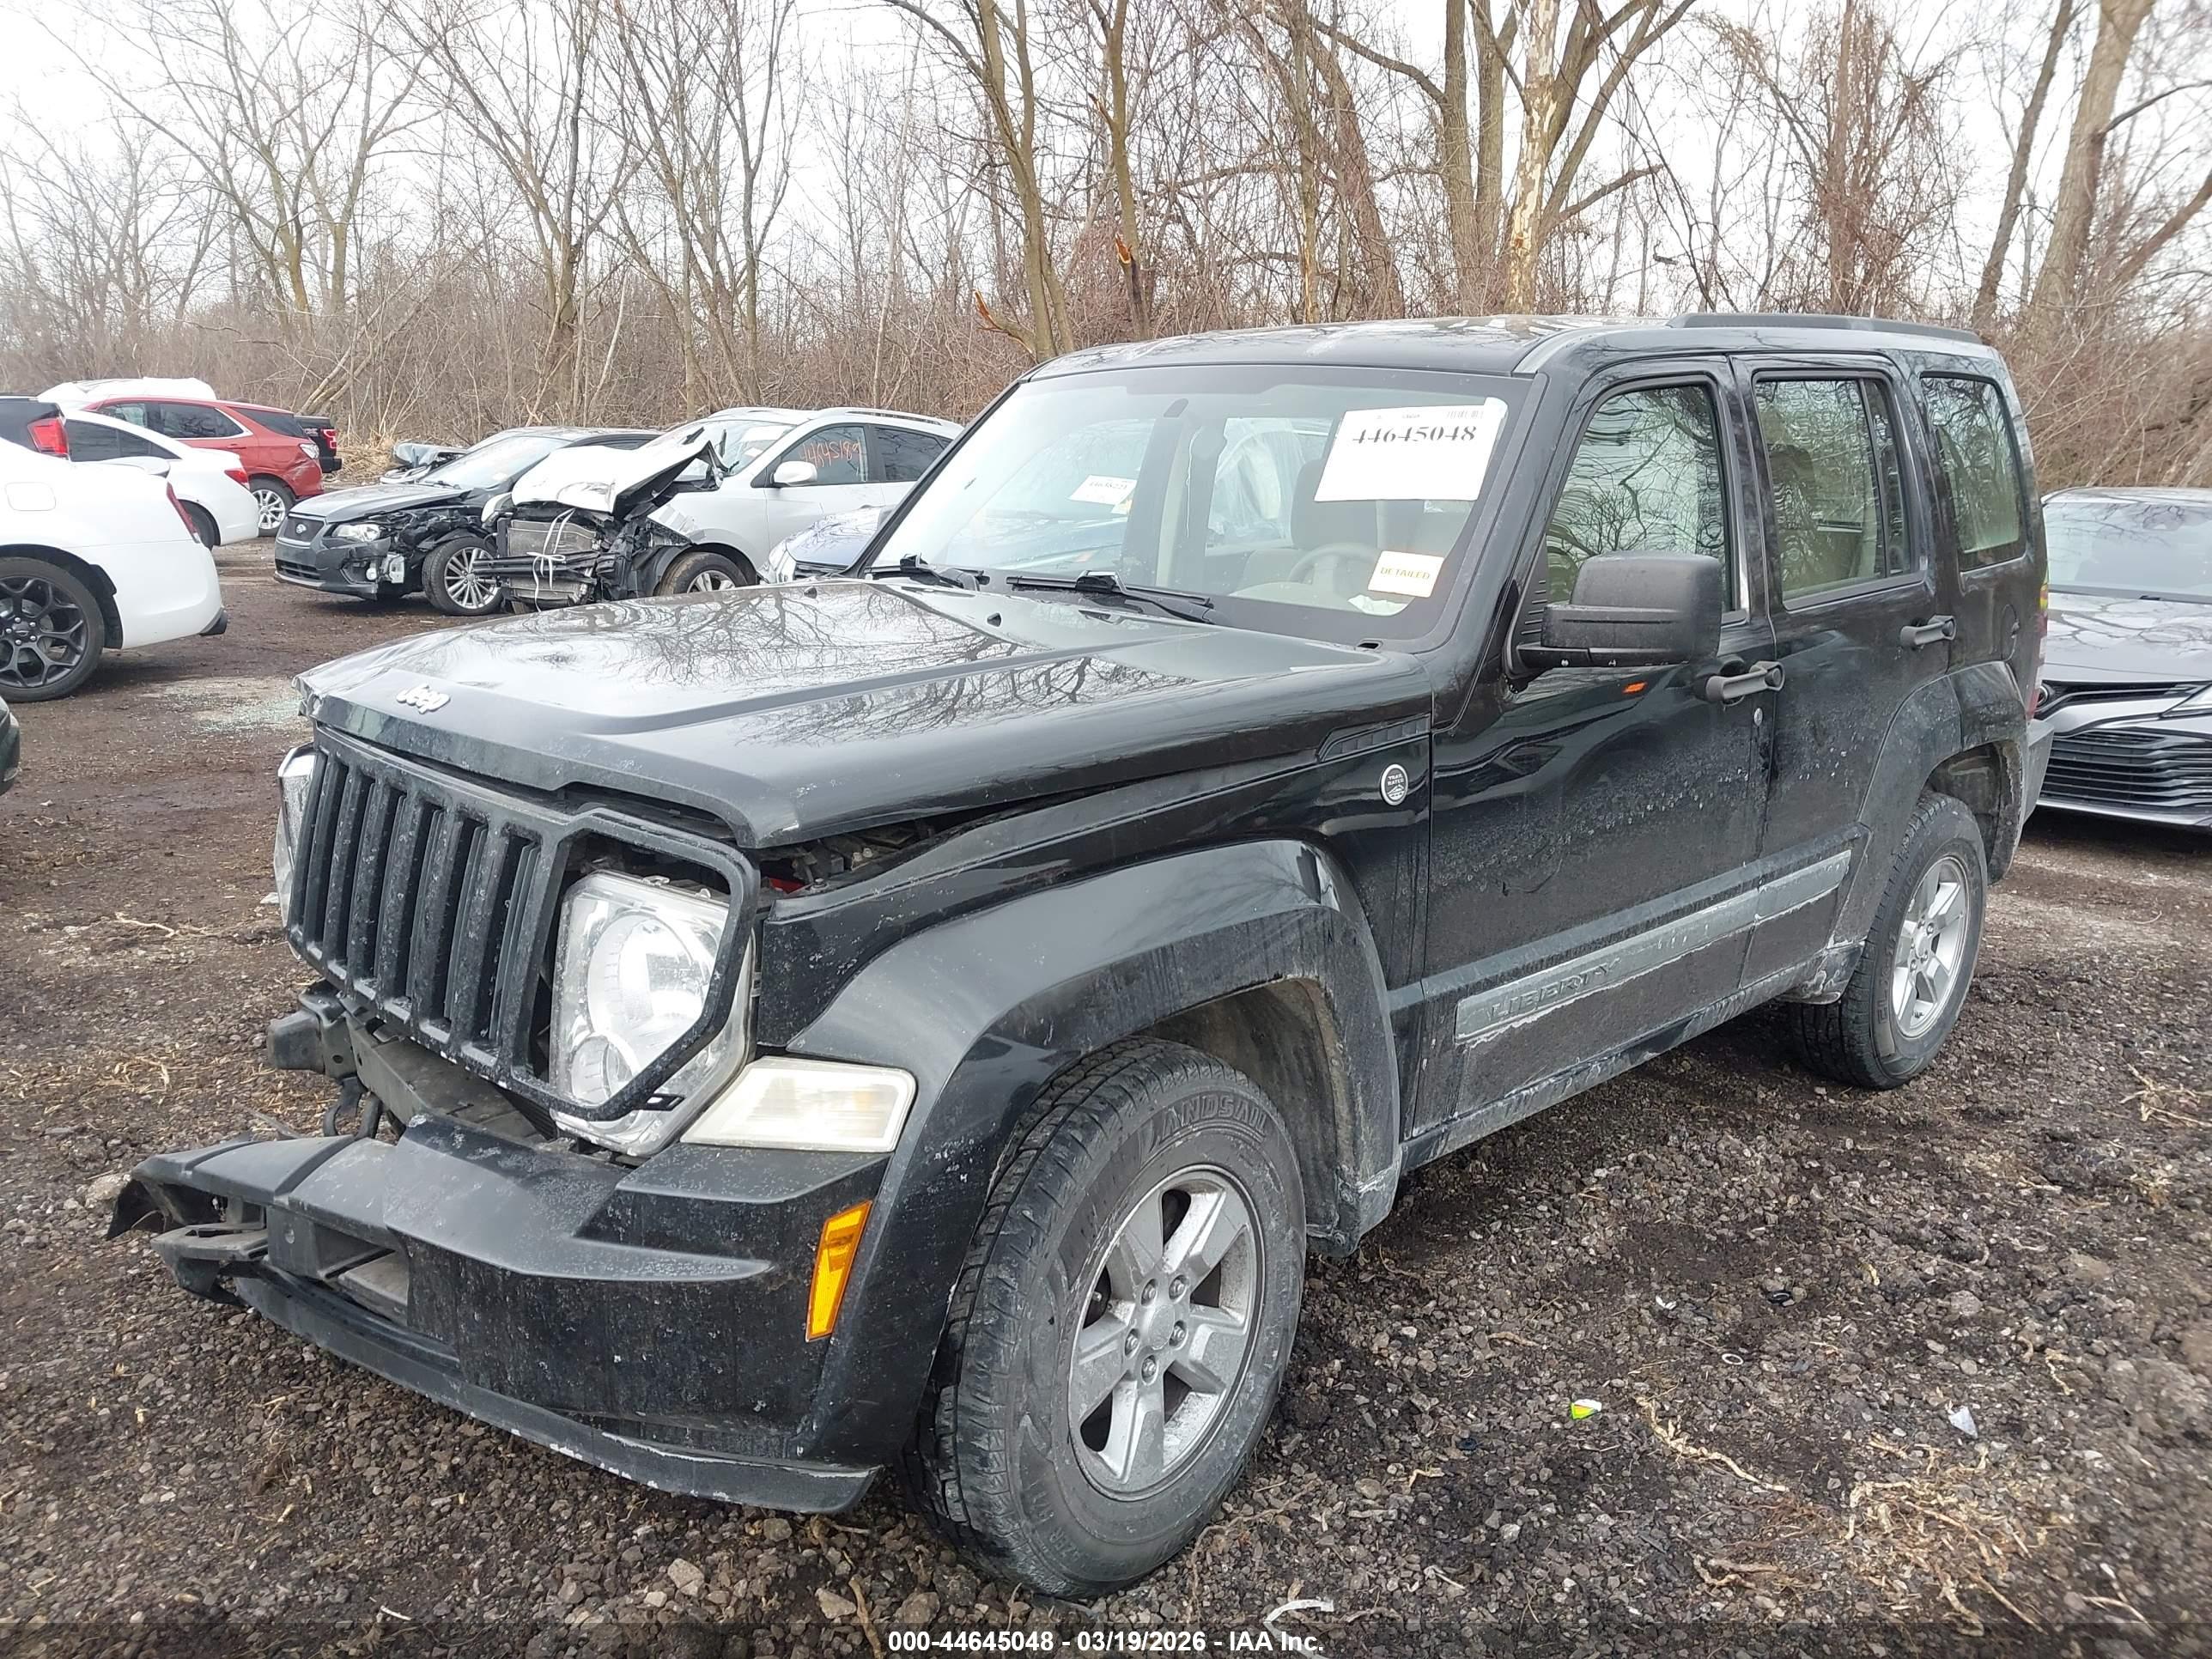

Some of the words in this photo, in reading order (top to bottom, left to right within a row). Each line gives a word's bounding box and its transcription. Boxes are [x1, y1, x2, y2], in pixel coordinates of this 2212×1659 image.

[1352, 425, 1477, 444] 44645048
[1380, 567, 1431, 580] DETAILED
[1387, 778, 1404, 787] RATED
[1490, 957, 1622, 1019] LIBERTY
